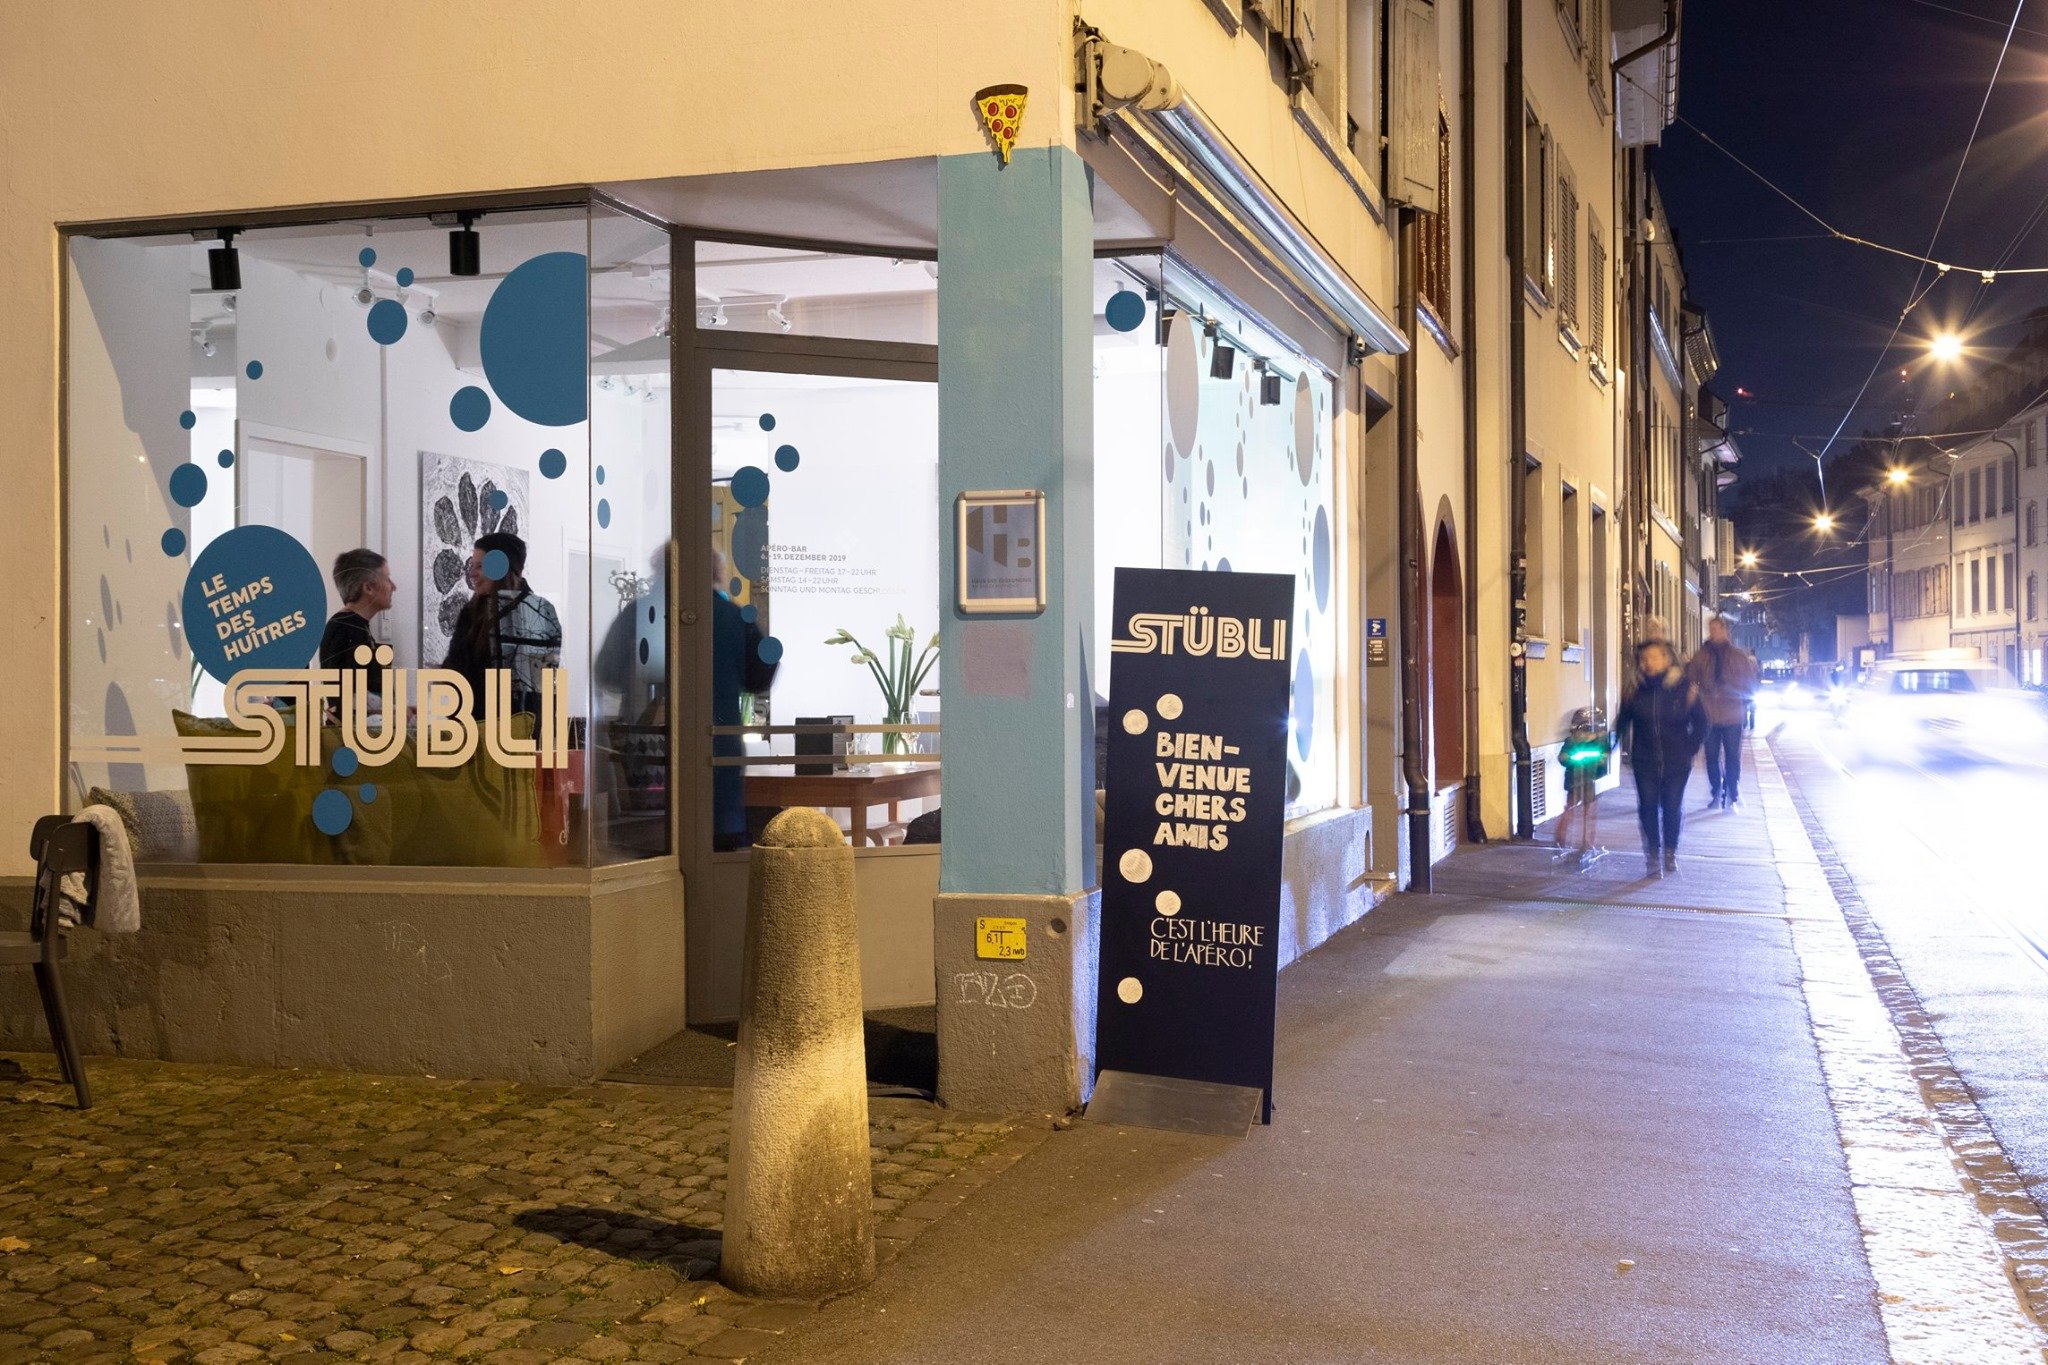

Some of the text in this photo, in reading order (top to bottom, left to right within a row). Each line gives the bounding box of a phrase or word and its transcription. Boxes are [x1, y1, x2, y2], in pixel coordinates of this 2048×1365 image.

[784, 553, 827, 562] DEZEMBER
[828, 554, 847, 562] 2019
[201, 573, 227, 598] LE
[760, 576, 797, 584] SAMSTAG
[760, 585, 798, 593] SONNTAG
[799, 586, 816, 594] UND
[818, 586, 851, 594] MONTAG
[207, 576, 274, 618] TEMPS
[215, 609, 255, 640] DES
[223, 610, 307, 662] HUÎTRES
[1111, 605, 1287, 661] STÜBLI
[178, 644, 569, 769] STÜBLI
[1155, 731, 1241, 761] BIEN-
[1155, 762, 1251, 794] VENUE
[1154, 792, 1247, 823] CHERS
[1152, 822, 1229, 851] AMIS
[979, 919, 986, 930] S
[1151, 917, 1265, 947] C'EST L'HEURE
[1150, 938, 1170, 961] DE
